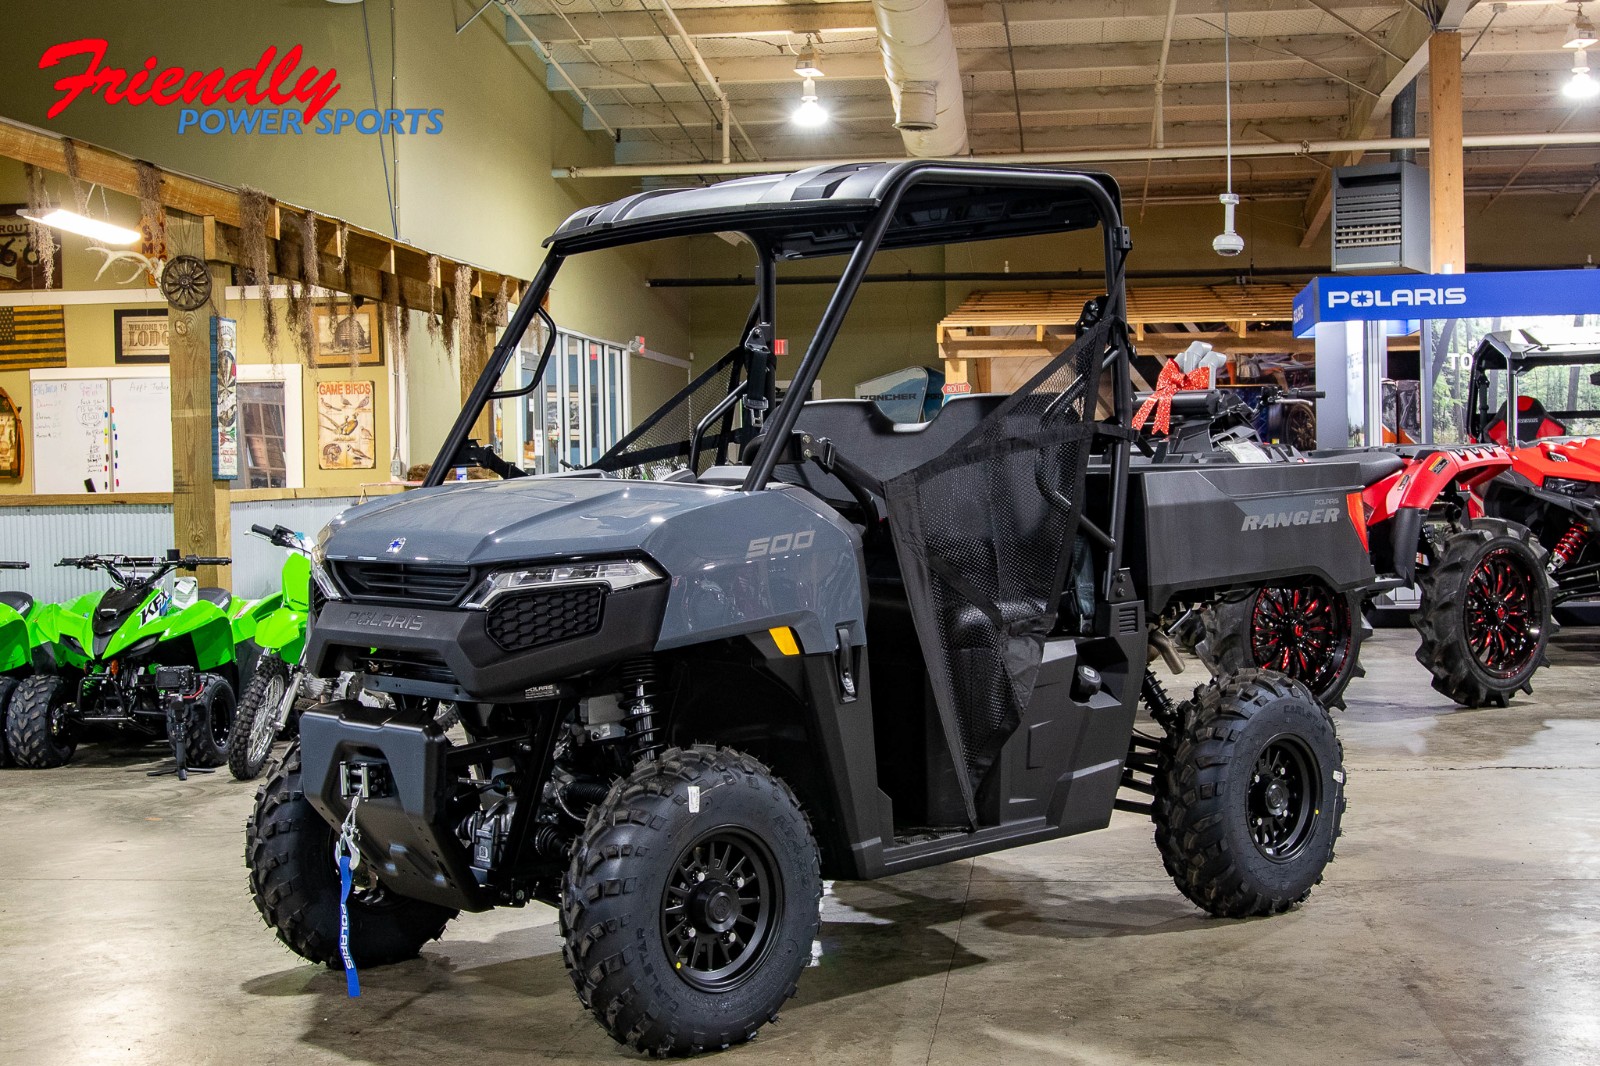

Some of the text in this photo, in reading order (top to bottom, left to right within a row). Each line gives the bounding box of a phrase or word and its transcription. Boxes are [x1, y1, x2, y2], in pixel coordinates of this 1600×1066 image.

[0, 223, 30, 233] ROUT
[1327, 287, 1467, 309] POLARIS
[128, 323, 168, 332] WELCOME TO
[128, 330, 170, 347] LODG
[319, 383, 371, 395] GAME BIRDS
[946, 383, 966, 393] ROUTE
[860, 393, 917, 402] RANCHER
[1314, 498, 1340, 506] POLARIS
[1241, 507, 1340, 532] RANGER
[745, 530, 816, 559] 500
[140, 591, 168, 626] KFX
[344, 611, 423, 631] POLARIS
[340, 903, 355, 970] POLARIS
